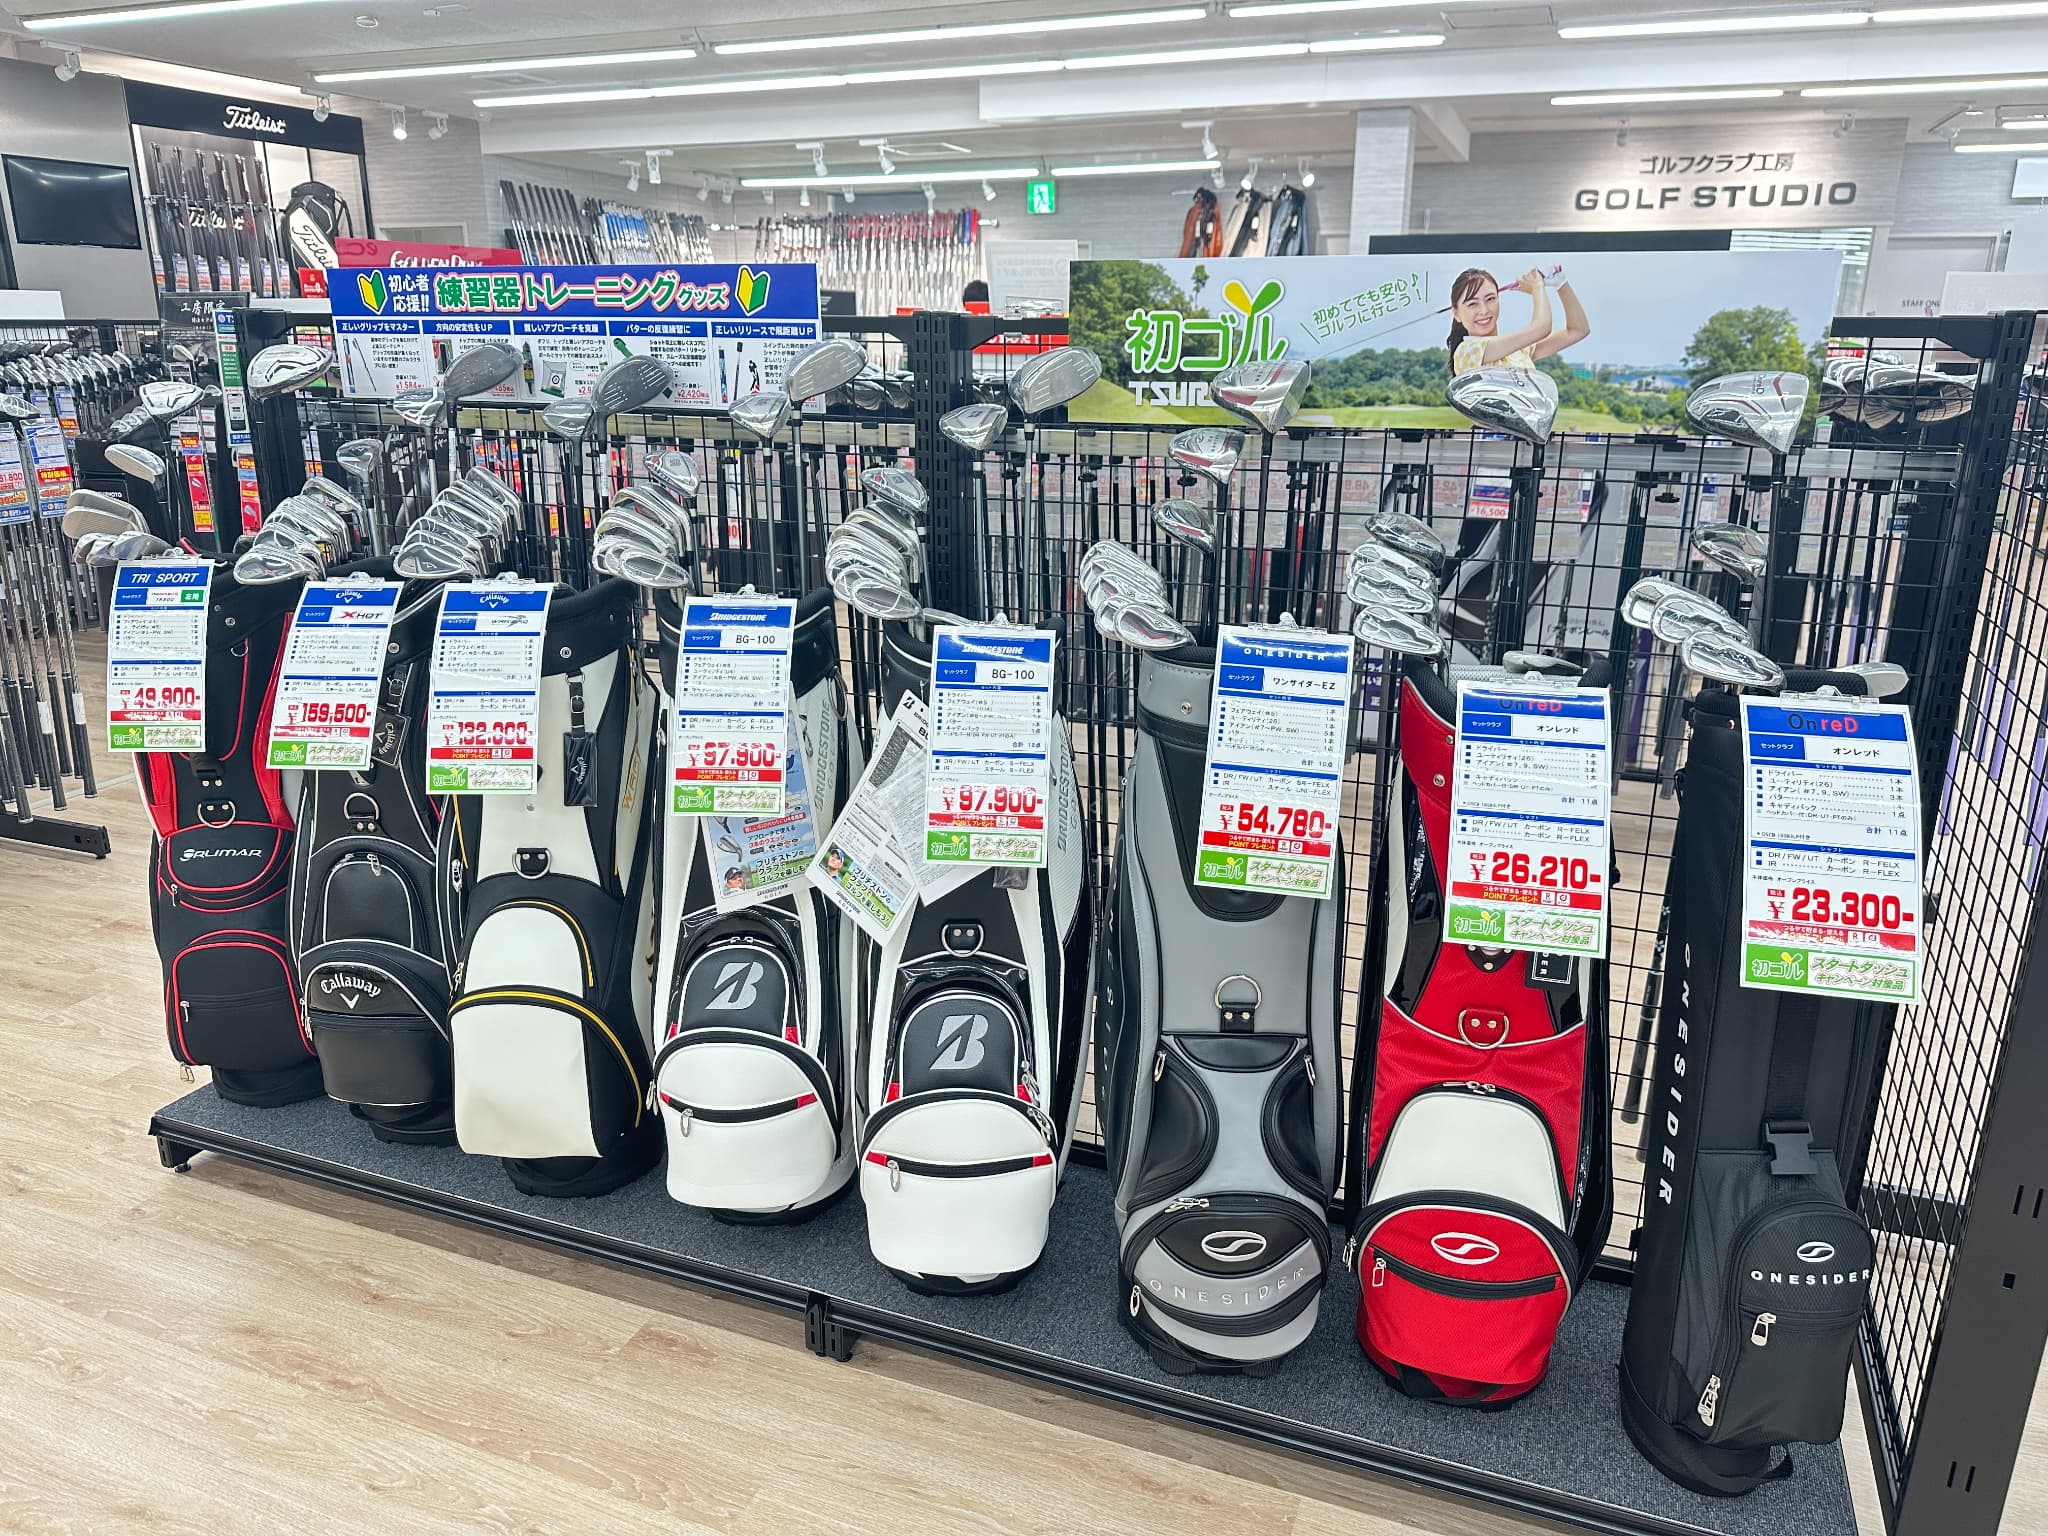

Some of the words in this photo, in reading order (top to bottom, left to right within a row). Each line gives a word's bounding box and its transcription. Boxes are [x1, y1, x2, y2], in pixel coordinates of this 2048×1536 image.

[223, 105, 286, 134] Titleist
[1640, 152, 1795, 175] ゴルフクラブ工房
[1576, 186, 1681, 211] GOLF
[1694, 181, 1857, 209] STUDIO
[388, 274, 430, 292] 初心者
[1125, 293, 1290, 374] 初ゴル
[1129, 381, 1220, 407] TSUR
[131, 574, 151, 583] TRI
[156, 573, 199, 583] SPORT
[709, 612, 768, 622] BRIDGESTONE
[736, 634, 775, 645] BG-100
[992, 669, 1034, 680] BG-100
[1228, 674, 1255, 682] セットクラブ
[1273, 677, 1336, 690] ワンサイダーEZ
[1471, 720, 1502, 728] セットクラブ
[1536, 724, 1579, 734] オンレッド
[1787, 713, 1859, 734] OnreD
[1760, 742, 1794, 750] セットクラブ
[1833, 747, 1880, 758] オンレッド
[814, 700, 830, 811] BRIDGESTONE
[1768, 769, 1803, 777] ドライバー
[1866, 826, 1881, 835] 合計
[1889, 828, 1907, 836] 11点
[1826, 856, 1856, 865] カーボン
[1826, 865, 1856, 874] カーボン
[1484, 892, 1506, 900] POINT
[1509, 894, 1538, 903] プレゼント
[1454, 913, 1501, 935] 初ゴル
[1510, 915, 1595, 934] スタートダッシュ
[1752, 956, 1804, 979] 初ゴル
[1811, 957, 1909, 978] スタートダッシュ
[320, 973, 381, 997] Callaway
[1816, 973, 1905, 990] キャンペーン対象品
[1659, 943, 1691, 1205] ONESIDER
[1751, 1269, 1869, 1285] ONESIDER
[1150, 1268, 1303, 1305] ONESIDER
